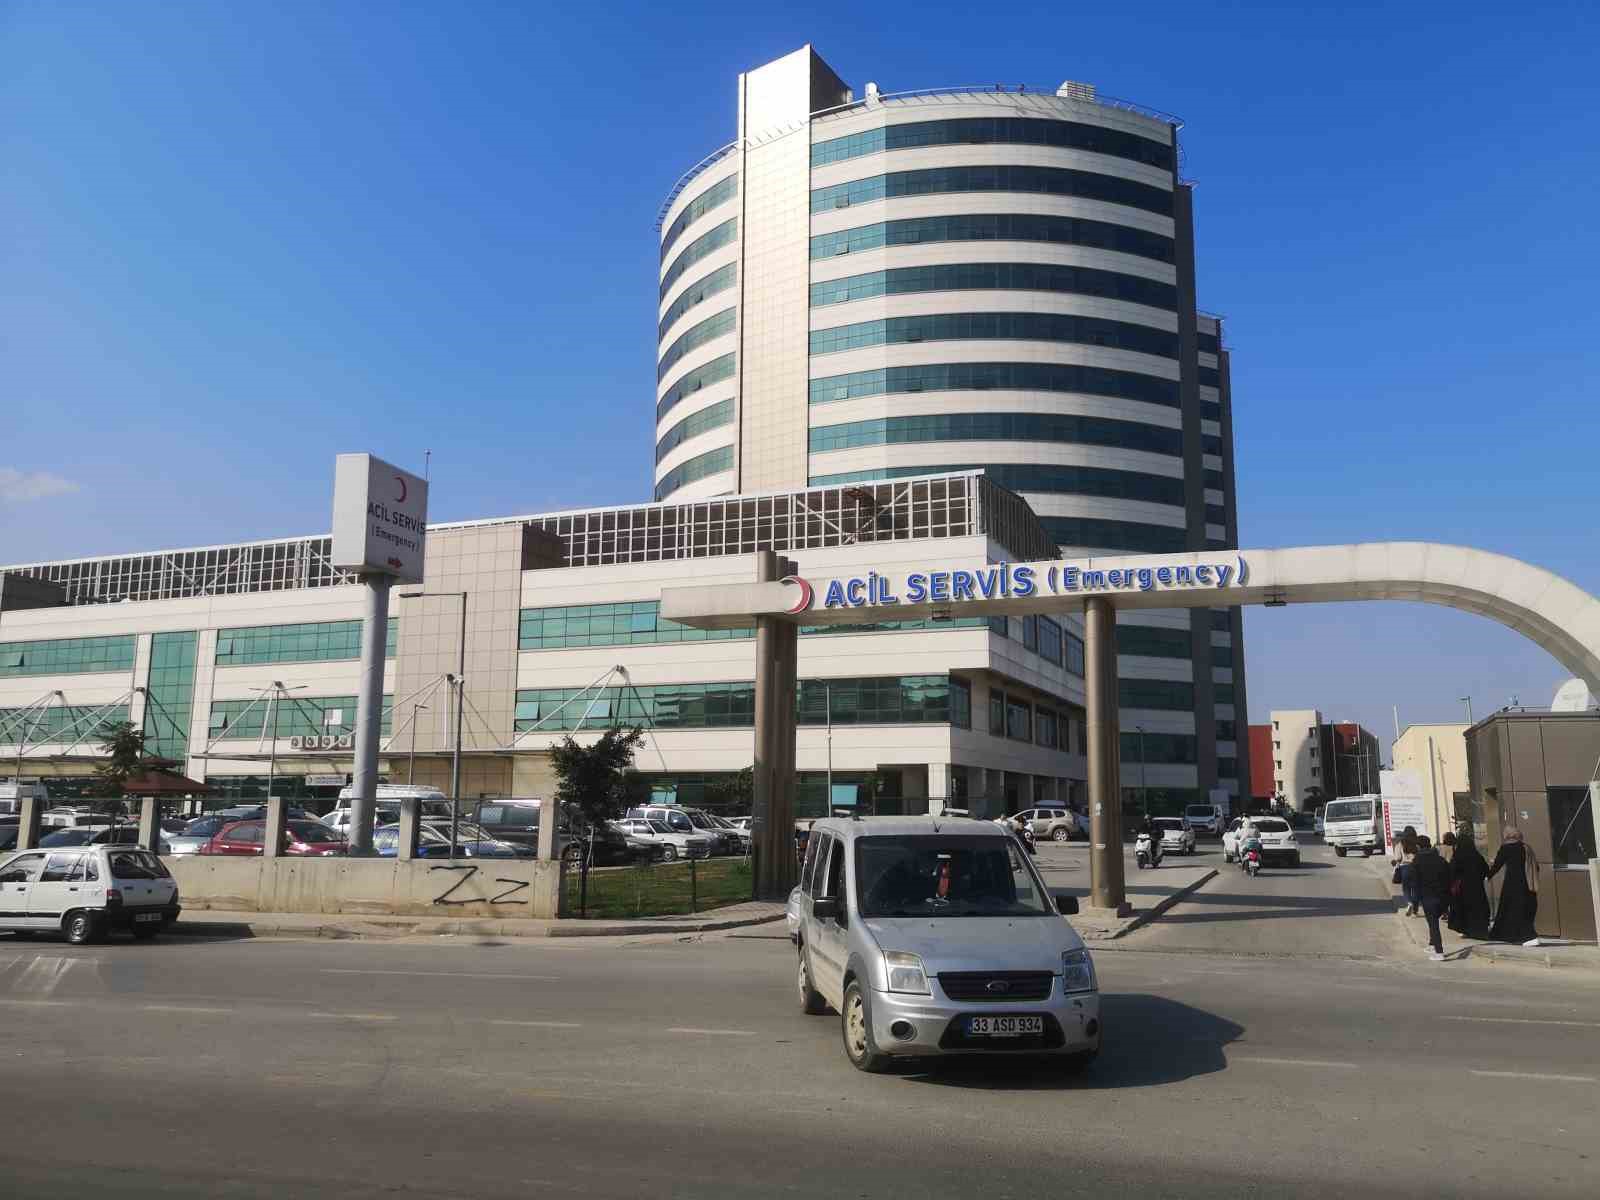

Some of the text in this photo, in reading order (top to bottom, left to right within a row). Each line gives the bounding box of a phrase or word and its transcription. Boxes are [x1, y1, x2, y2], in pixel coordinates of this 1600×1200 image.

[368, 502, 426, 535] ACİL SERVİS
[371, 523, 420, 552] (Emergency)
[825, 556, 1247, 607] ACİL SERVİS (Emergency)
[973, 1016, 1041, 1032] 33 ASD 934
